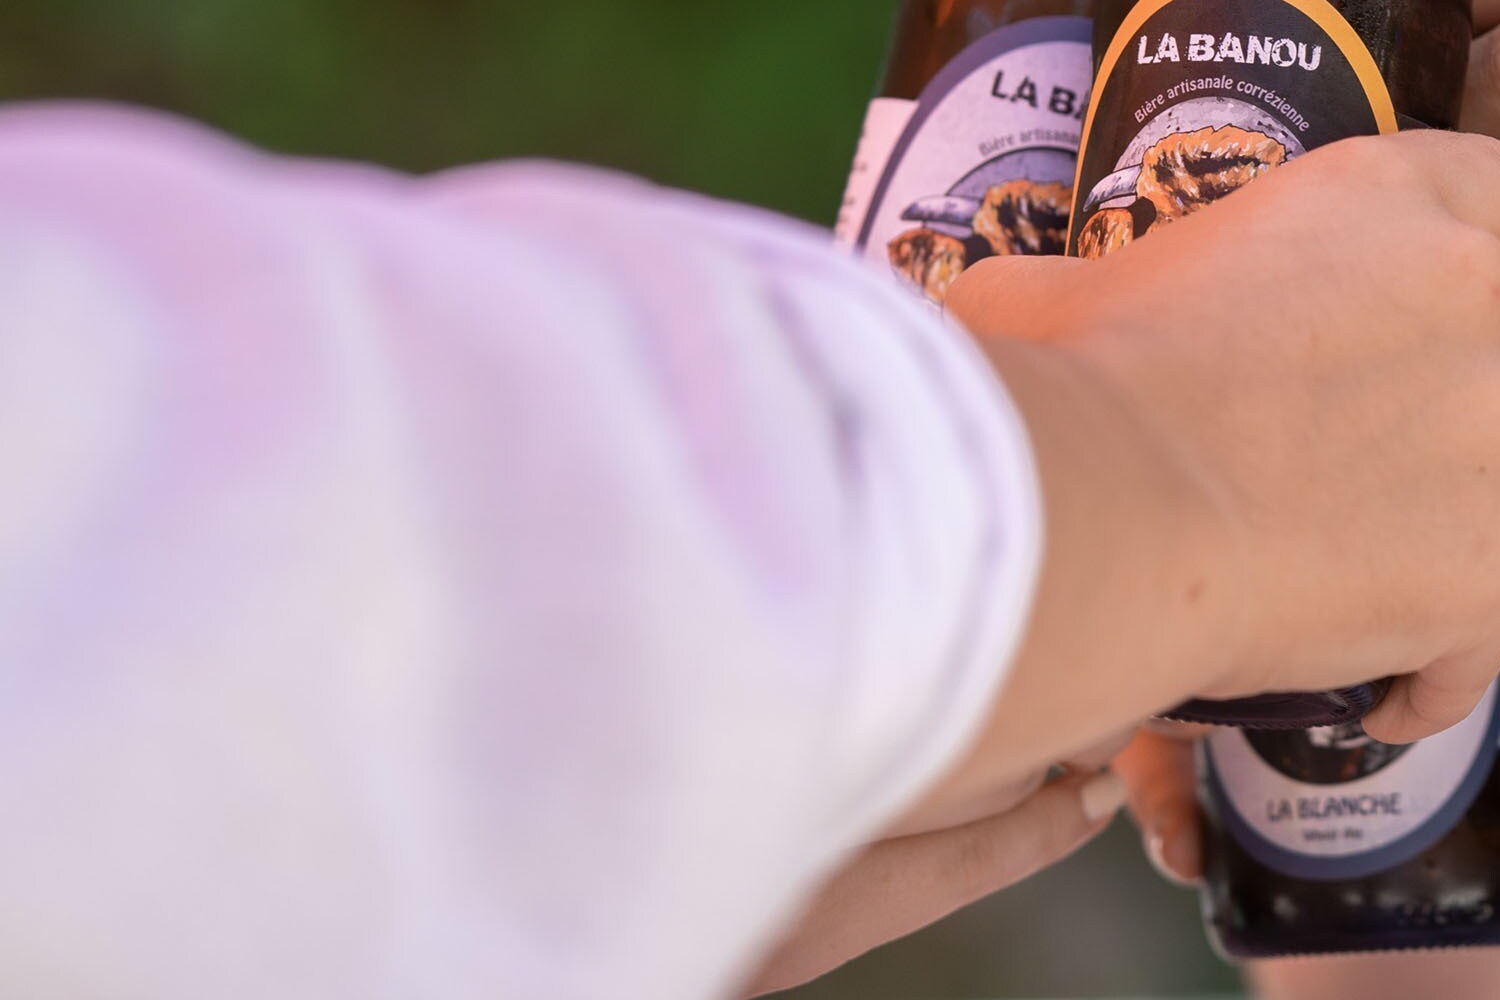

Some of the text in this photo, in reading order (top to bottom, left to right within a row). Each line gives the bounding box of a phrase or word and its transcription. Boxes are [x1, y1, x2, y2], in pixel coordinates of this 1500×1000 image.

[1137, 32, 1322, 71] LA BANOU
[990, 69, 1038, 109] LA
[1133, 75, 1311, 132] Bière artisanale corrézienne
[1266, 791, 1404, 823] LA BLANCHE
